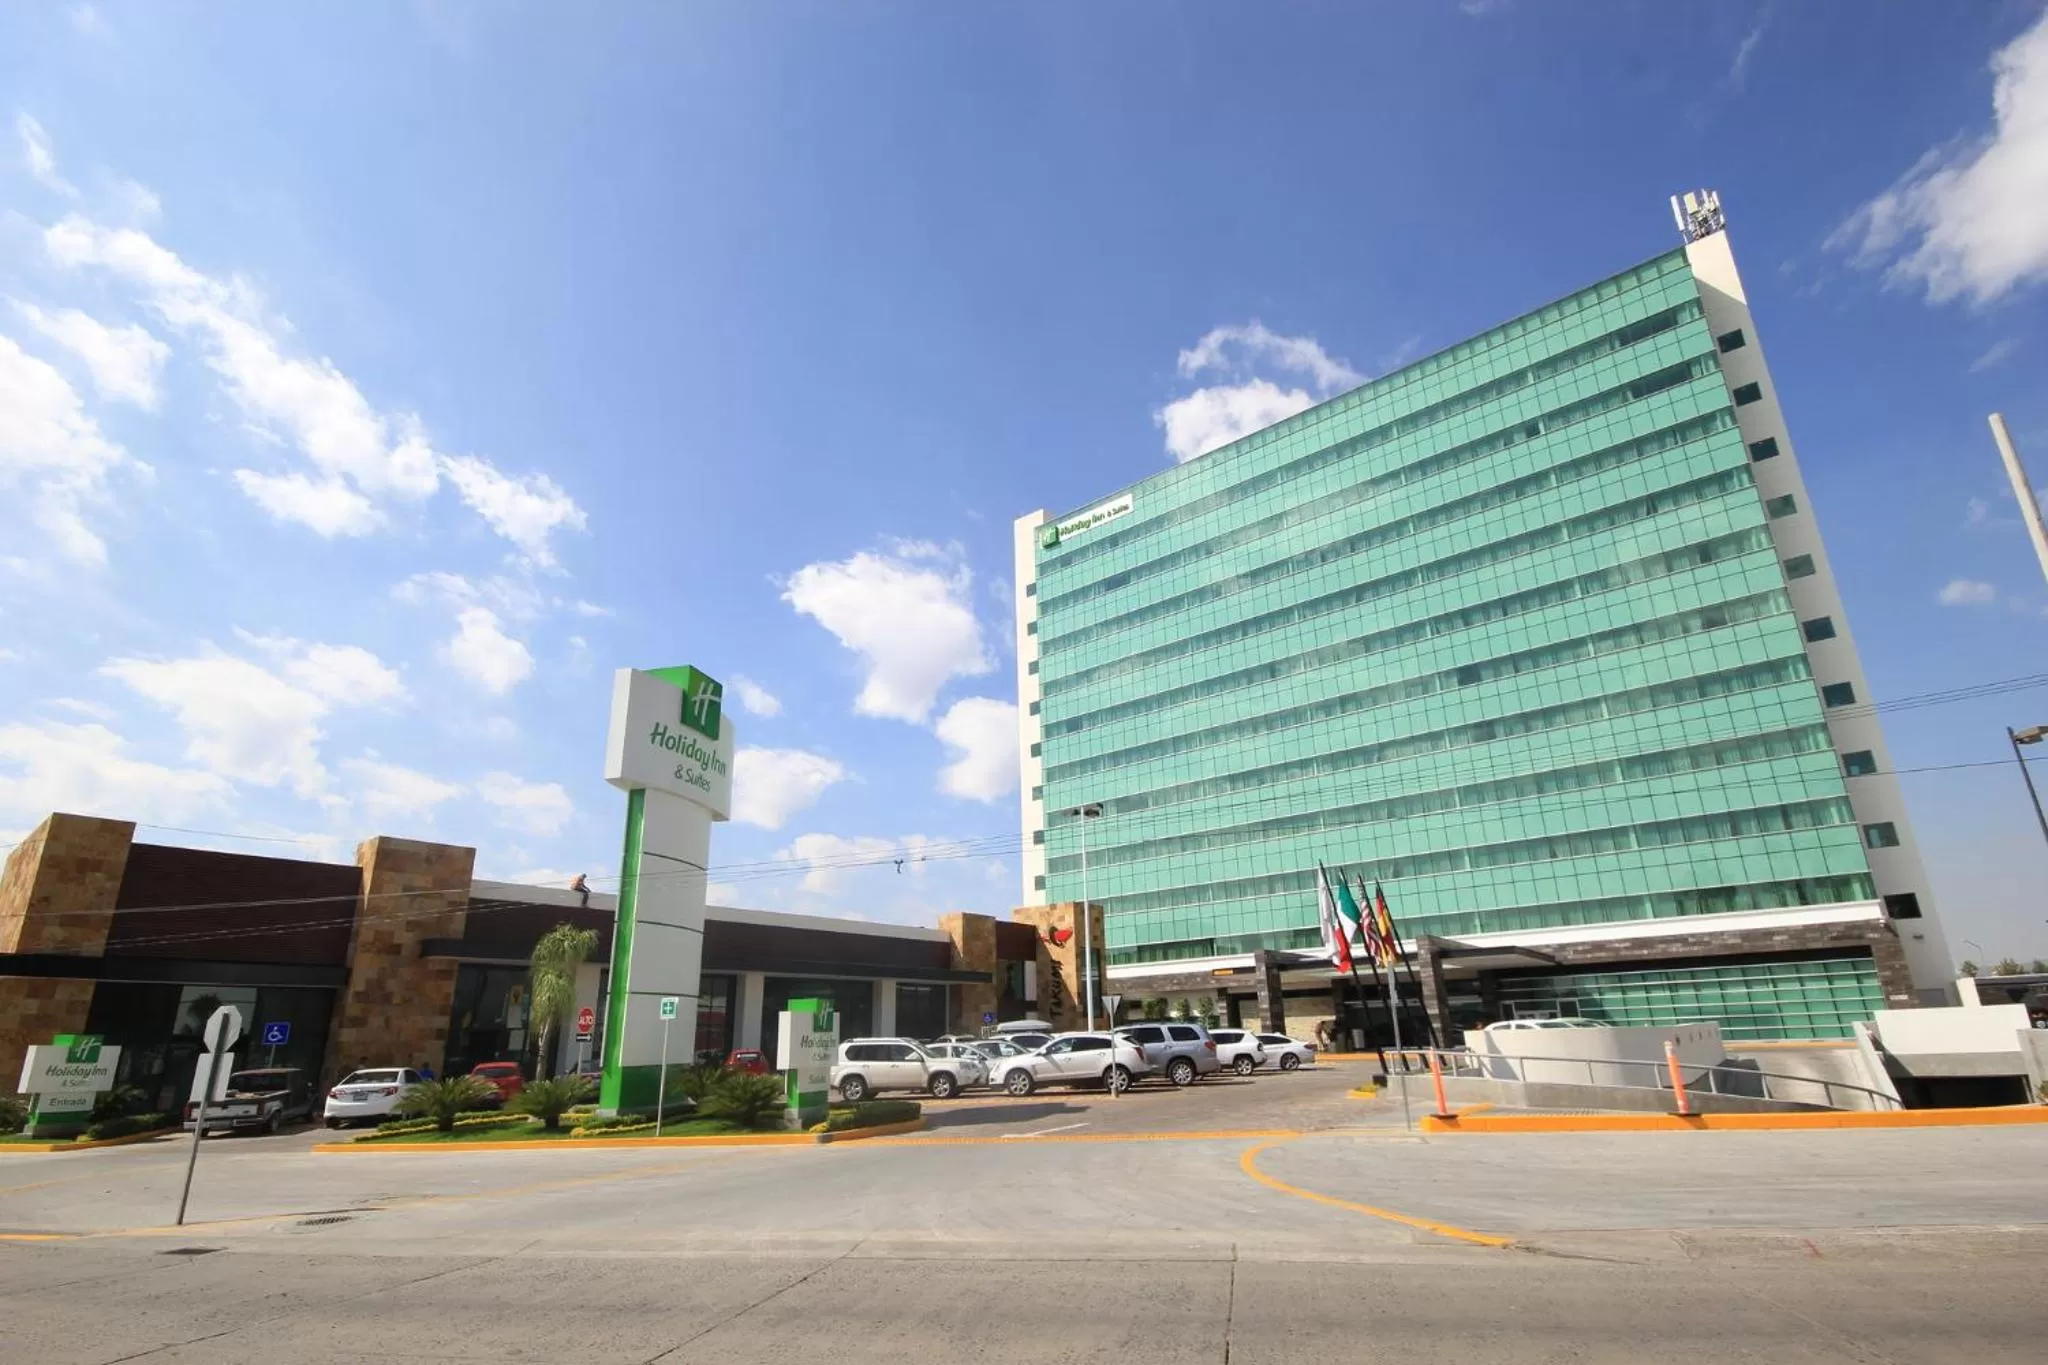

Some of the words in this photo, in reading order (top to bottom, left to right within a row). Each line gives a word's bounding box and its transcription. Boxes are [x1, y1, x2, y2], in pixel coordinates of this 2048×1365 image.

[650, 722, 711, 771] Holiday
[711, 749, 726, 778] Inn
[674, 764, 683, 780] &
[685, 768, 711, 792] Suites
[45, 1065, 91, 1078] Holiday
[91, 1065, 107, 1077] Inn
